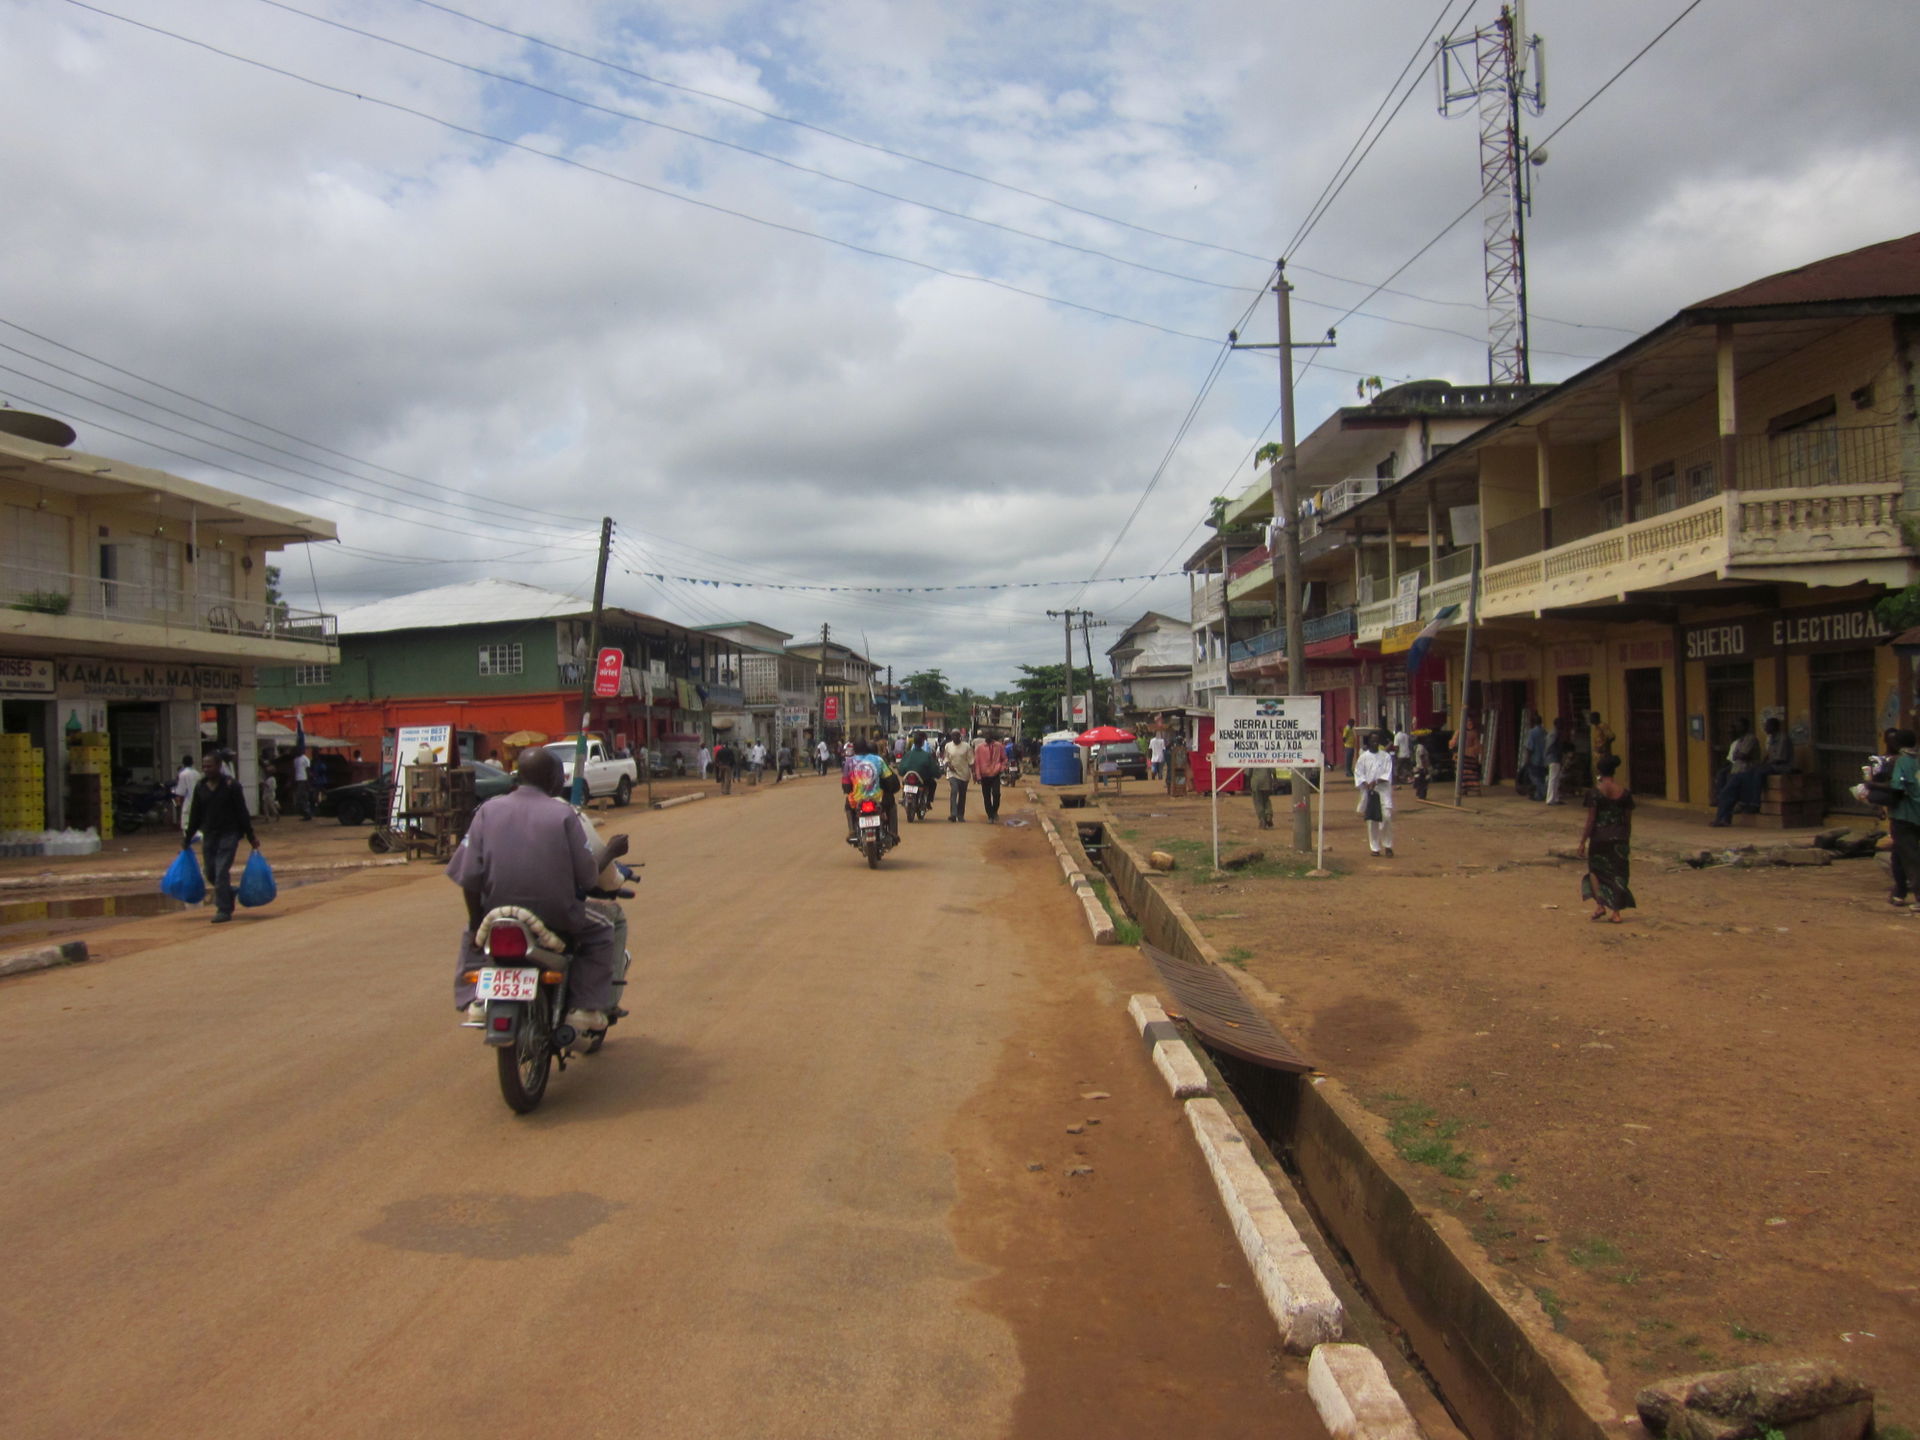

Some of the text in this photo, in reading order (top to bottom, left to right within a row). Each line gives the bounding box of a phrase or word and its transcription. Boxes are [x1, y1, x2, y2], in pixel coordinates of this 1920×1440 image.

[1687, 624, 1744, 658] SHERO
[58, 663, 130, 685] KAMAL
[166, 669, 241, 689] MANSOUR
[599, 668, 618, 677] airtel
[1234, 719, 1299, 729] SIERRA LEONE
[1219, 730, 1318, 740] KENEMA DISTRICT DEVELOPMENT
[493, 968, 522, 984] AFK
[493, 983, 520, 997] 953
